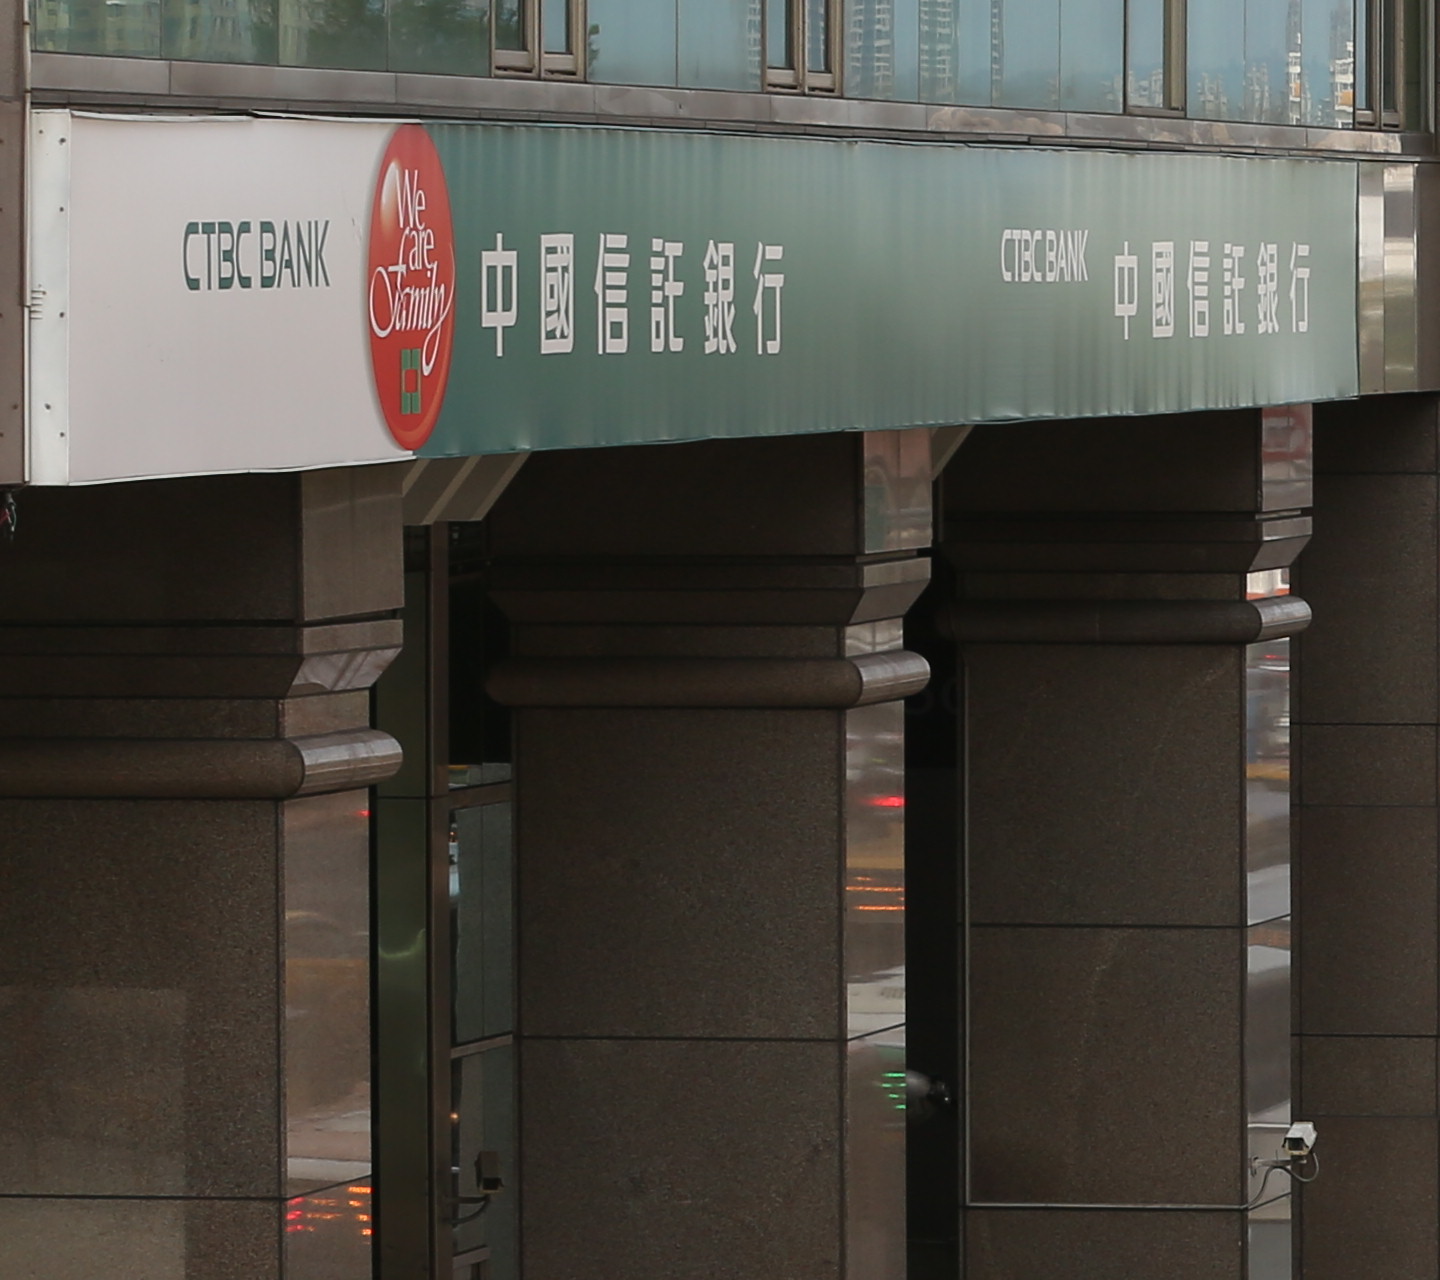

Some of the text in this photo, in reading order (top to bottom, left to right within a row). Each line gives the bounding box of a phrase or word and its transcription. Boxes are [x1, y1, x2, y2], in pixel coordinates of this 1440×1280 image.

[397, 168, 426, 231] We
[183, 220, 332, 291] CTBC BANK
[401, 225, 435, 273] care
[1001, 229, 1089, 282] CTBC BANK
[369, 256, 457, 377] Family
[480, 231, 786, 358] 中國信託銀行
[1114, 240, 1311, 340] 中國信託銀行
